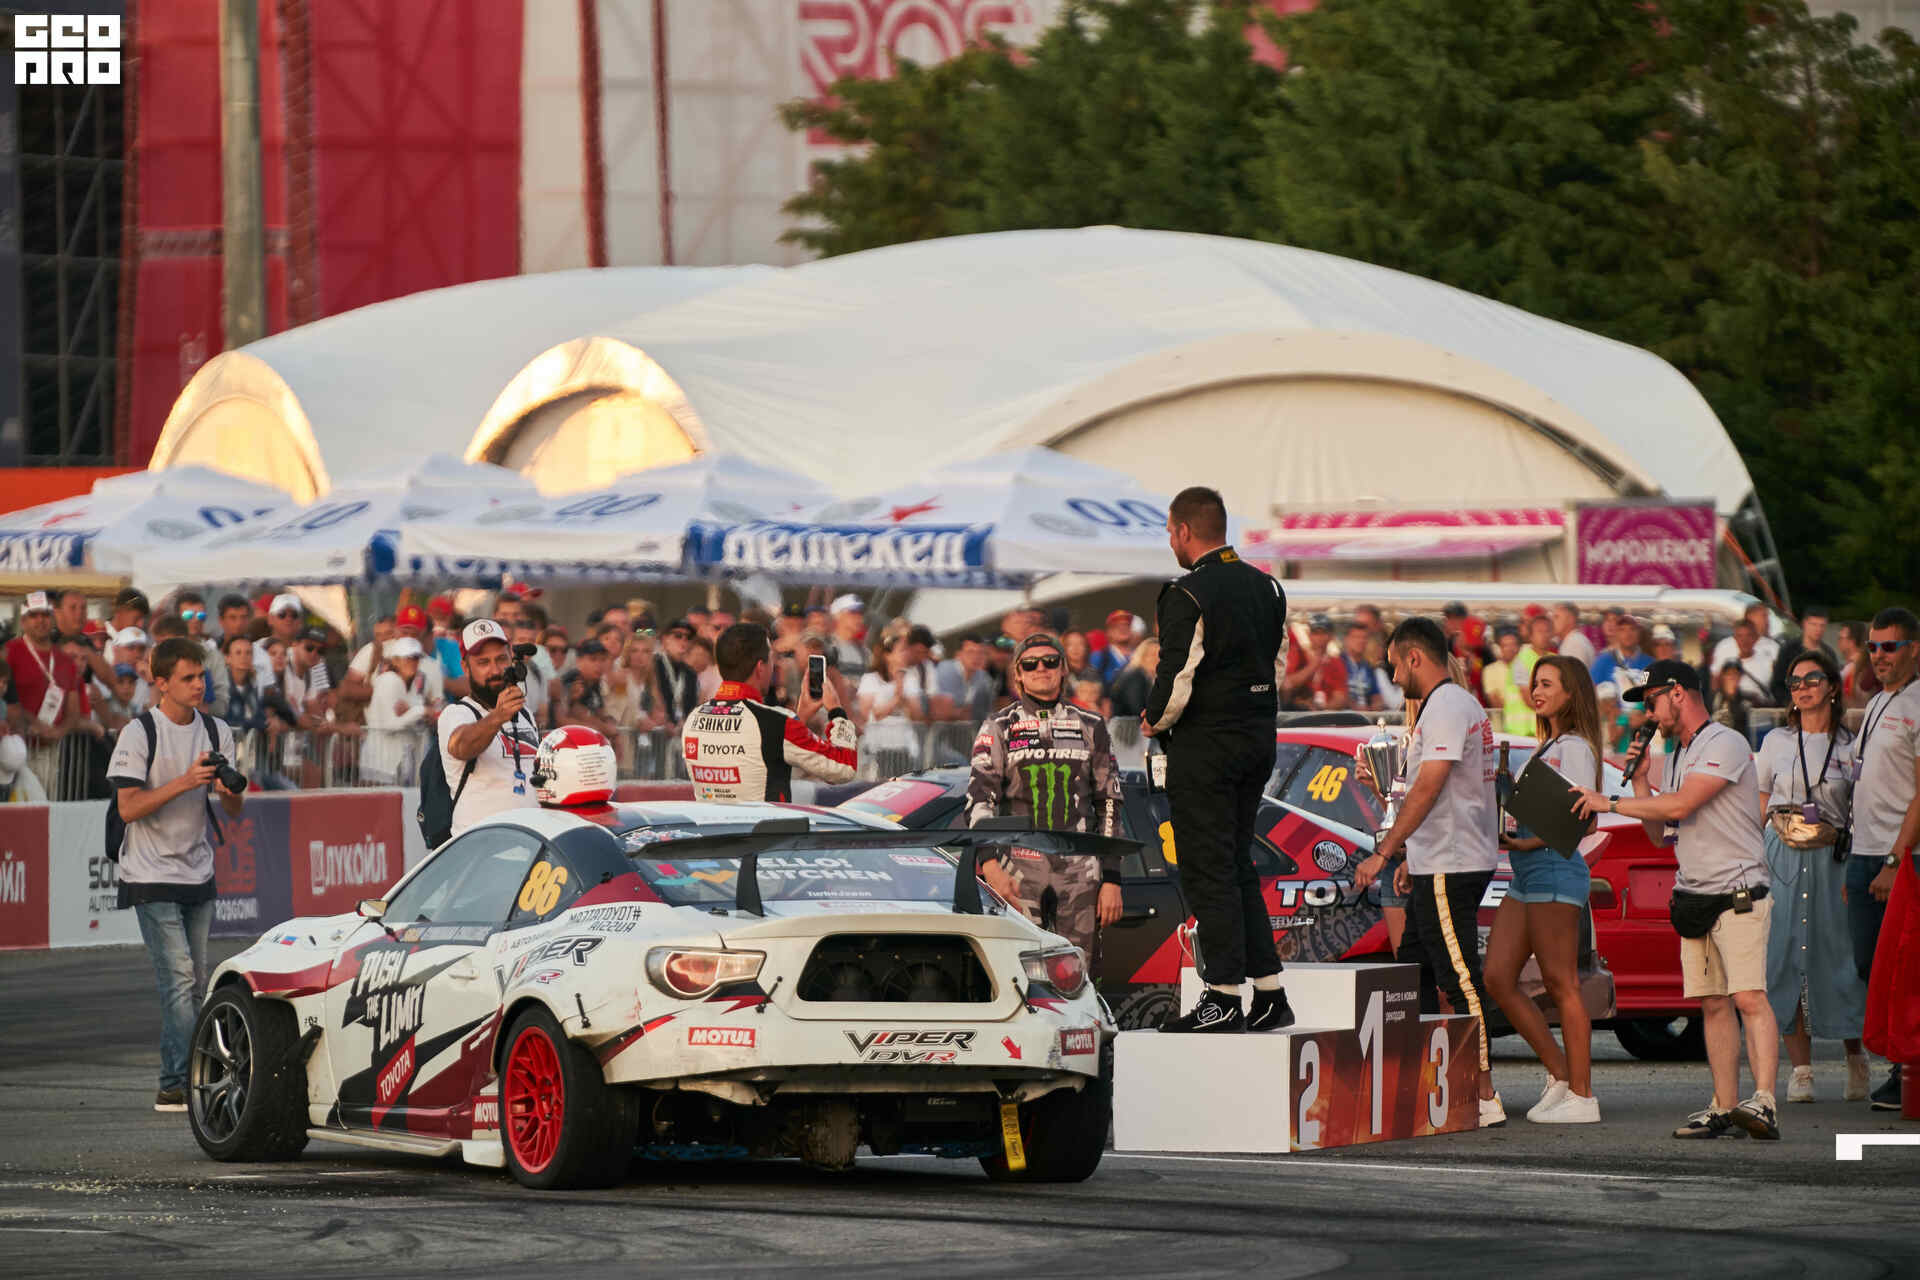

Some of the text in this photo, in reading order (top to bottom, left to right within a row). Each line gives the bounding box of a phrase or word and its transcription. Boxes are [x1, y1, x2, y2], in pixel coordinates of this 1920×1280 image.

[702, 743, 746, 755] TOYOTA
[1008, 748, 1090, 763] TOYO TIRES
[695, 767, 737, 782] MOTUL
[1307, 765, 1348, 802] 46
[325, 833, 387, 887] ЛУКОЙЛ
[518, 860, 568, 916] 86
[357, 950, 407, 997] PUSH
[379, 984, 426, 1052] LIMIT
[691, 1030, 753, 1046] MOTUL
[844, 1029, 978, 1055] VIPER
[866, 1049, 958, 1063] DVR
[1067, 1032, 1093, 1049] MOTUL
[380, 1049, 411, 1102] TOYOTA
[1358, 990, 1384, 1135] 1
[1428, 1026, 1450, 1128] 3
[1298, 1040, 1320, 1145] 2
